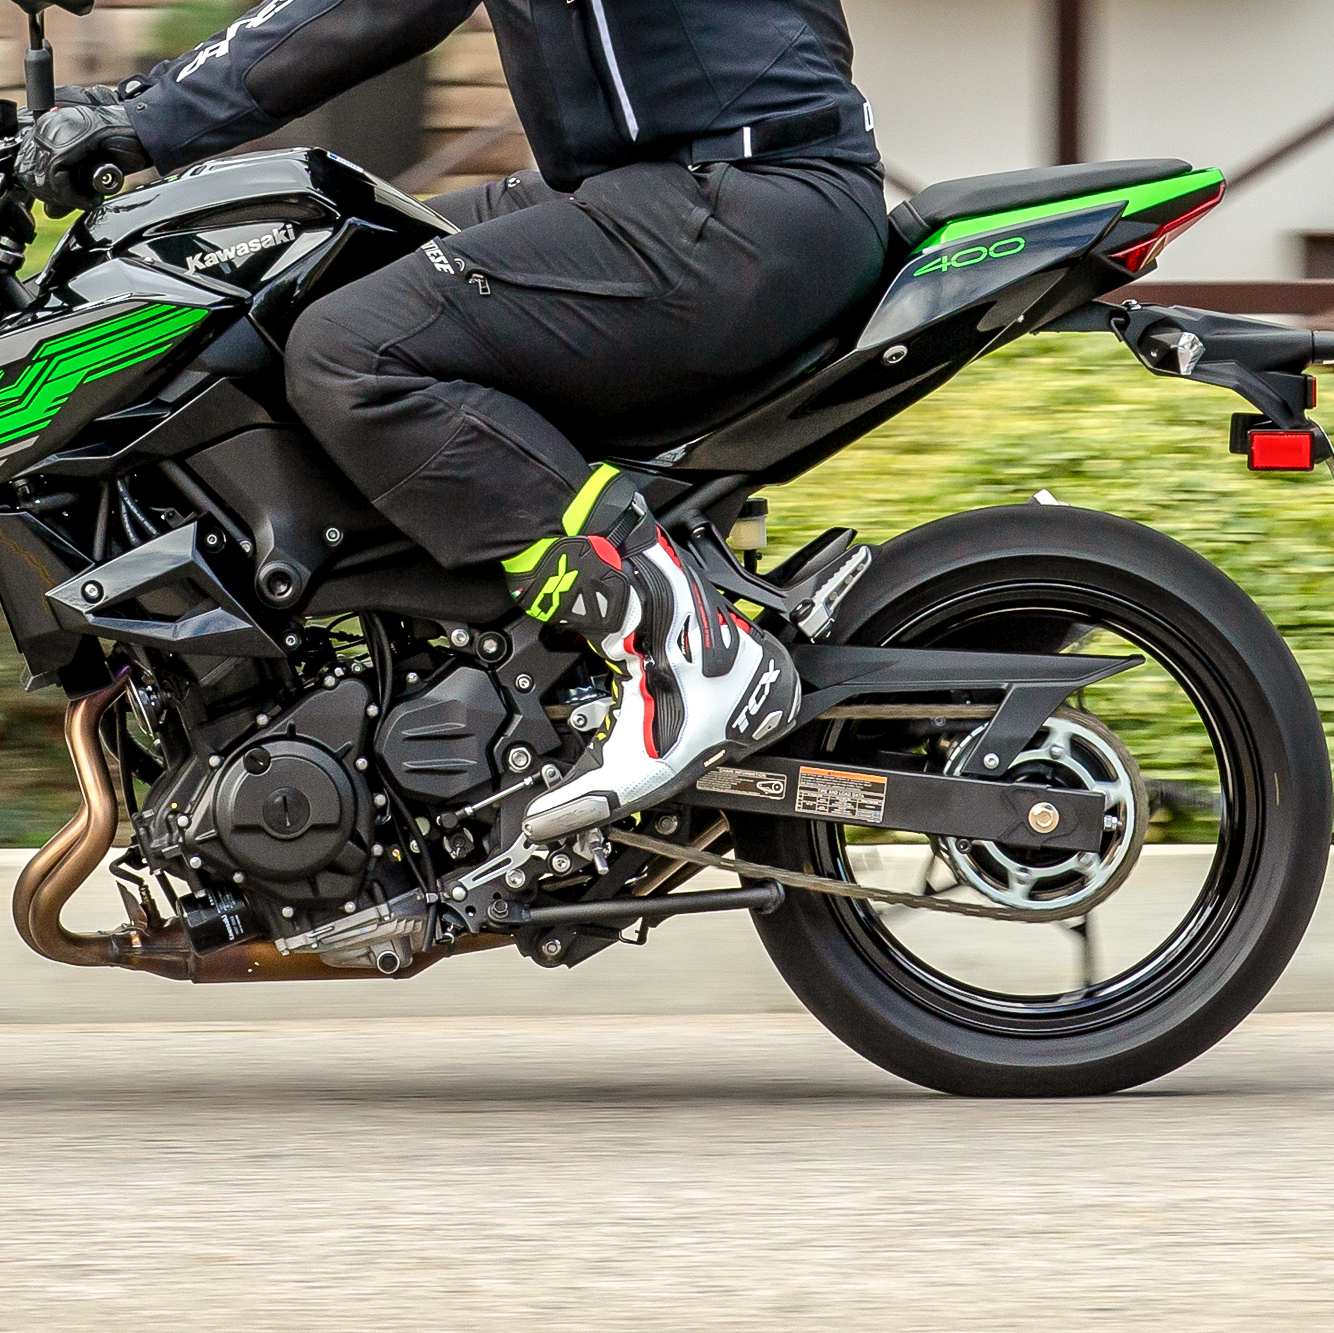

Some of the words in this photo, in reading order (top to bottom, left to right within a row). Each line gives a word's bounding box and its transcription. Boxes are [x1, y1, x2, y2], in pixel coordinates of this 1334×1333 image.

[184, 224, 296, 275] Kawasaki
[913, 237, 1026, 277] 400
[732, 659, 781, 733] TCX
